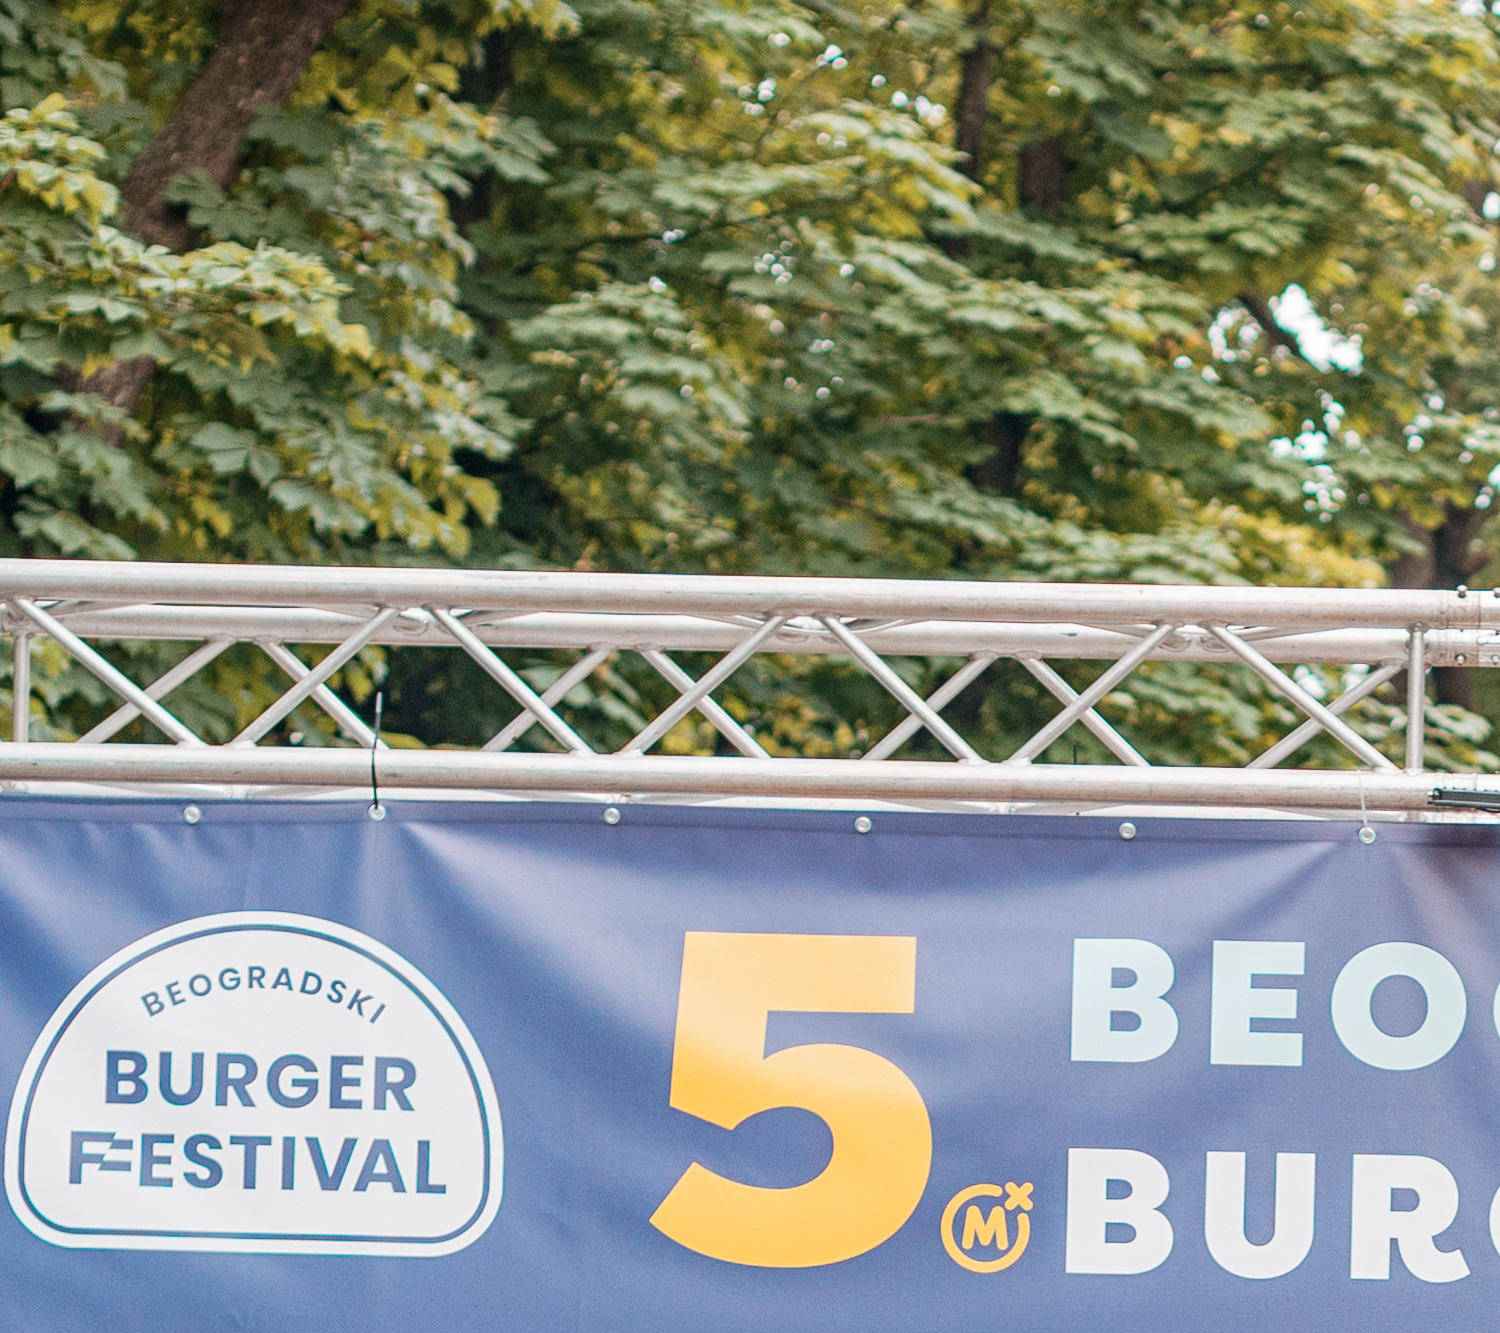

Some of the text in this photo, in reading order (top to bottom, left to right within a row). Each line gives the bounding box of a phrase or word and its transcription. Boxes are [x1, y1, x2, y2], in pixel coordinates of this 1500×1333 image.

[140, 965, 388, 1026] BEOGRADSKI
[104, 1048, 418, 1114] BURGER
[648, 931, 934, 1269] 5
[67, 1129, 449, 1197] FESTIVAL
